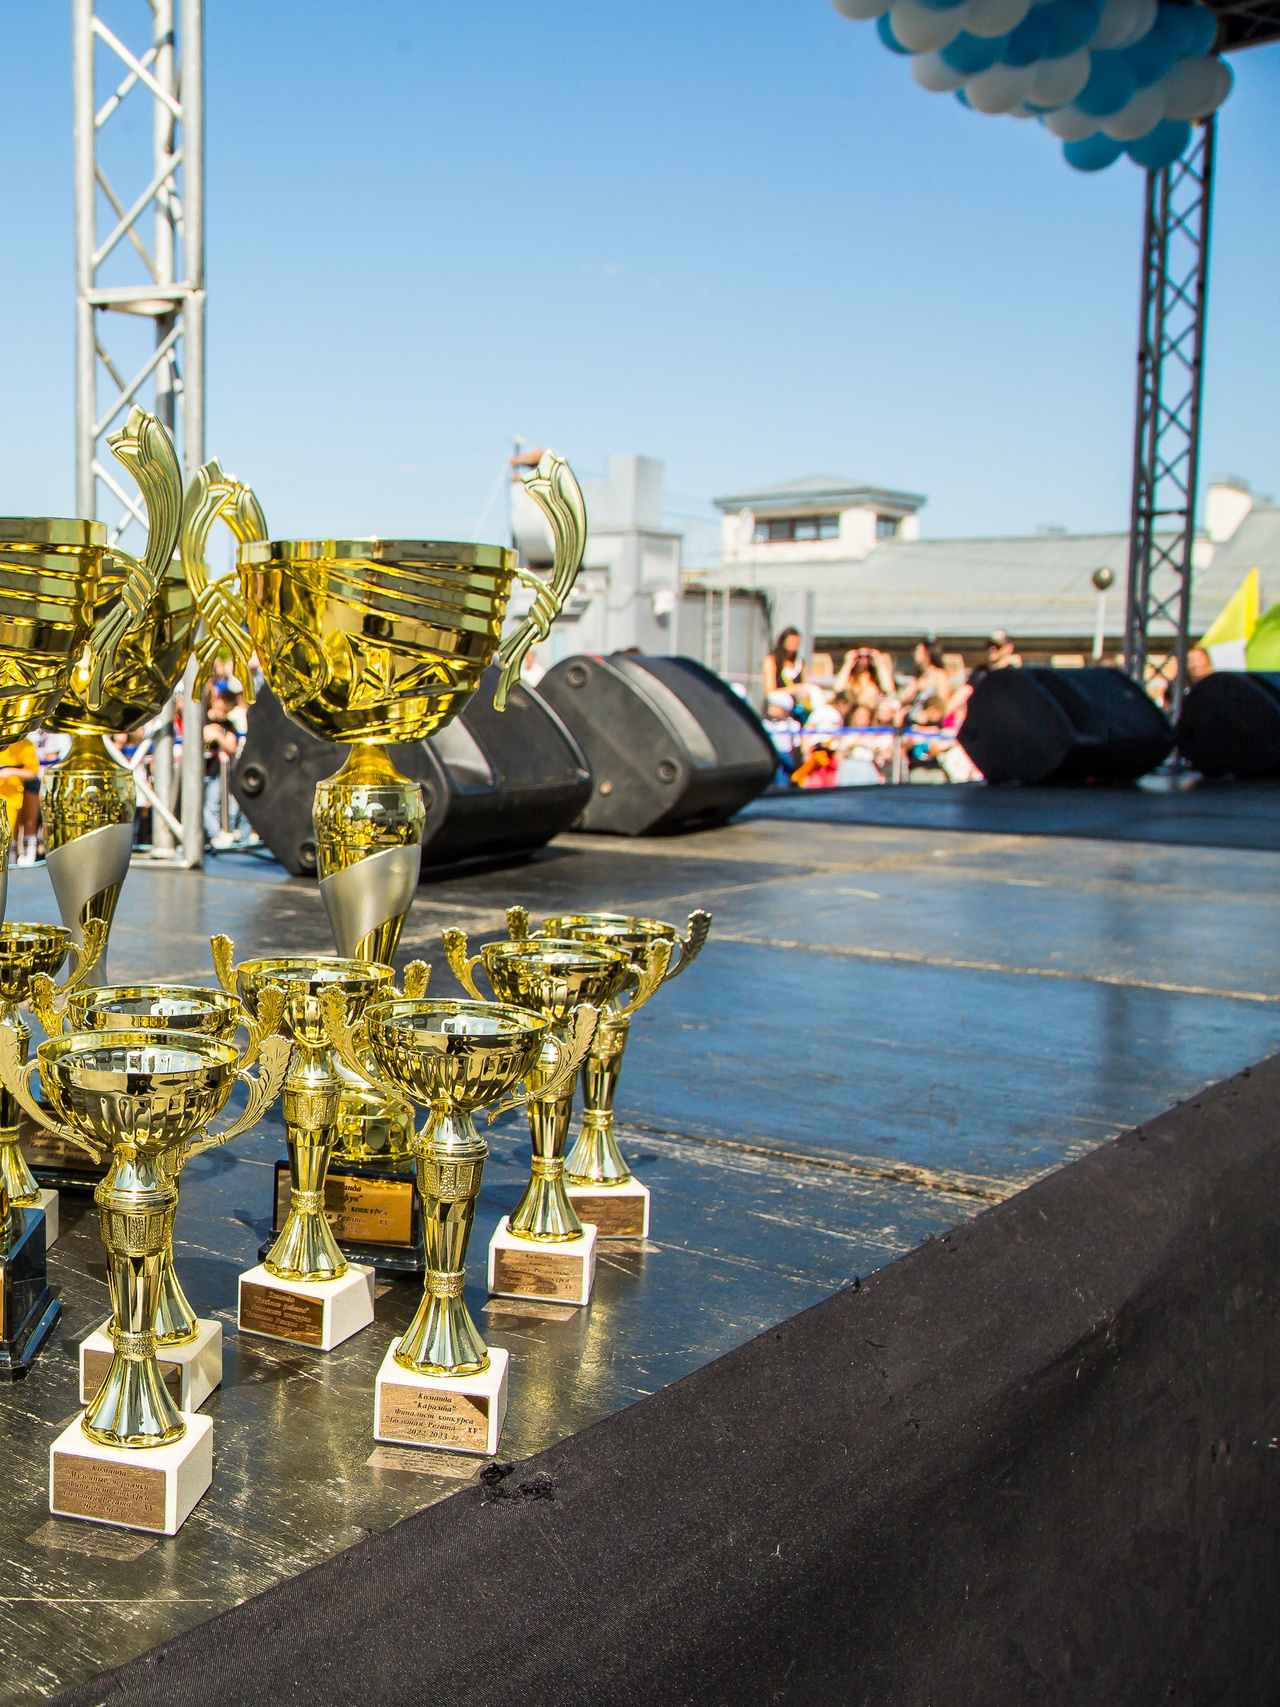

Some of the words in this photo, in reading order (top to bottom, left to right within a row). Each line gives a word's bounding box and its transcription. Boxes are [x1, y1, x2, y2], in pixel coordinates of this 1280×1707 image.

[418, 1393, 452, 1403] Команда
[414, 1401, 456, 1412] "Карамба"
[438, 1415, 474, 1424] конкурса
[427, 1421, 456, 1431] Регата
